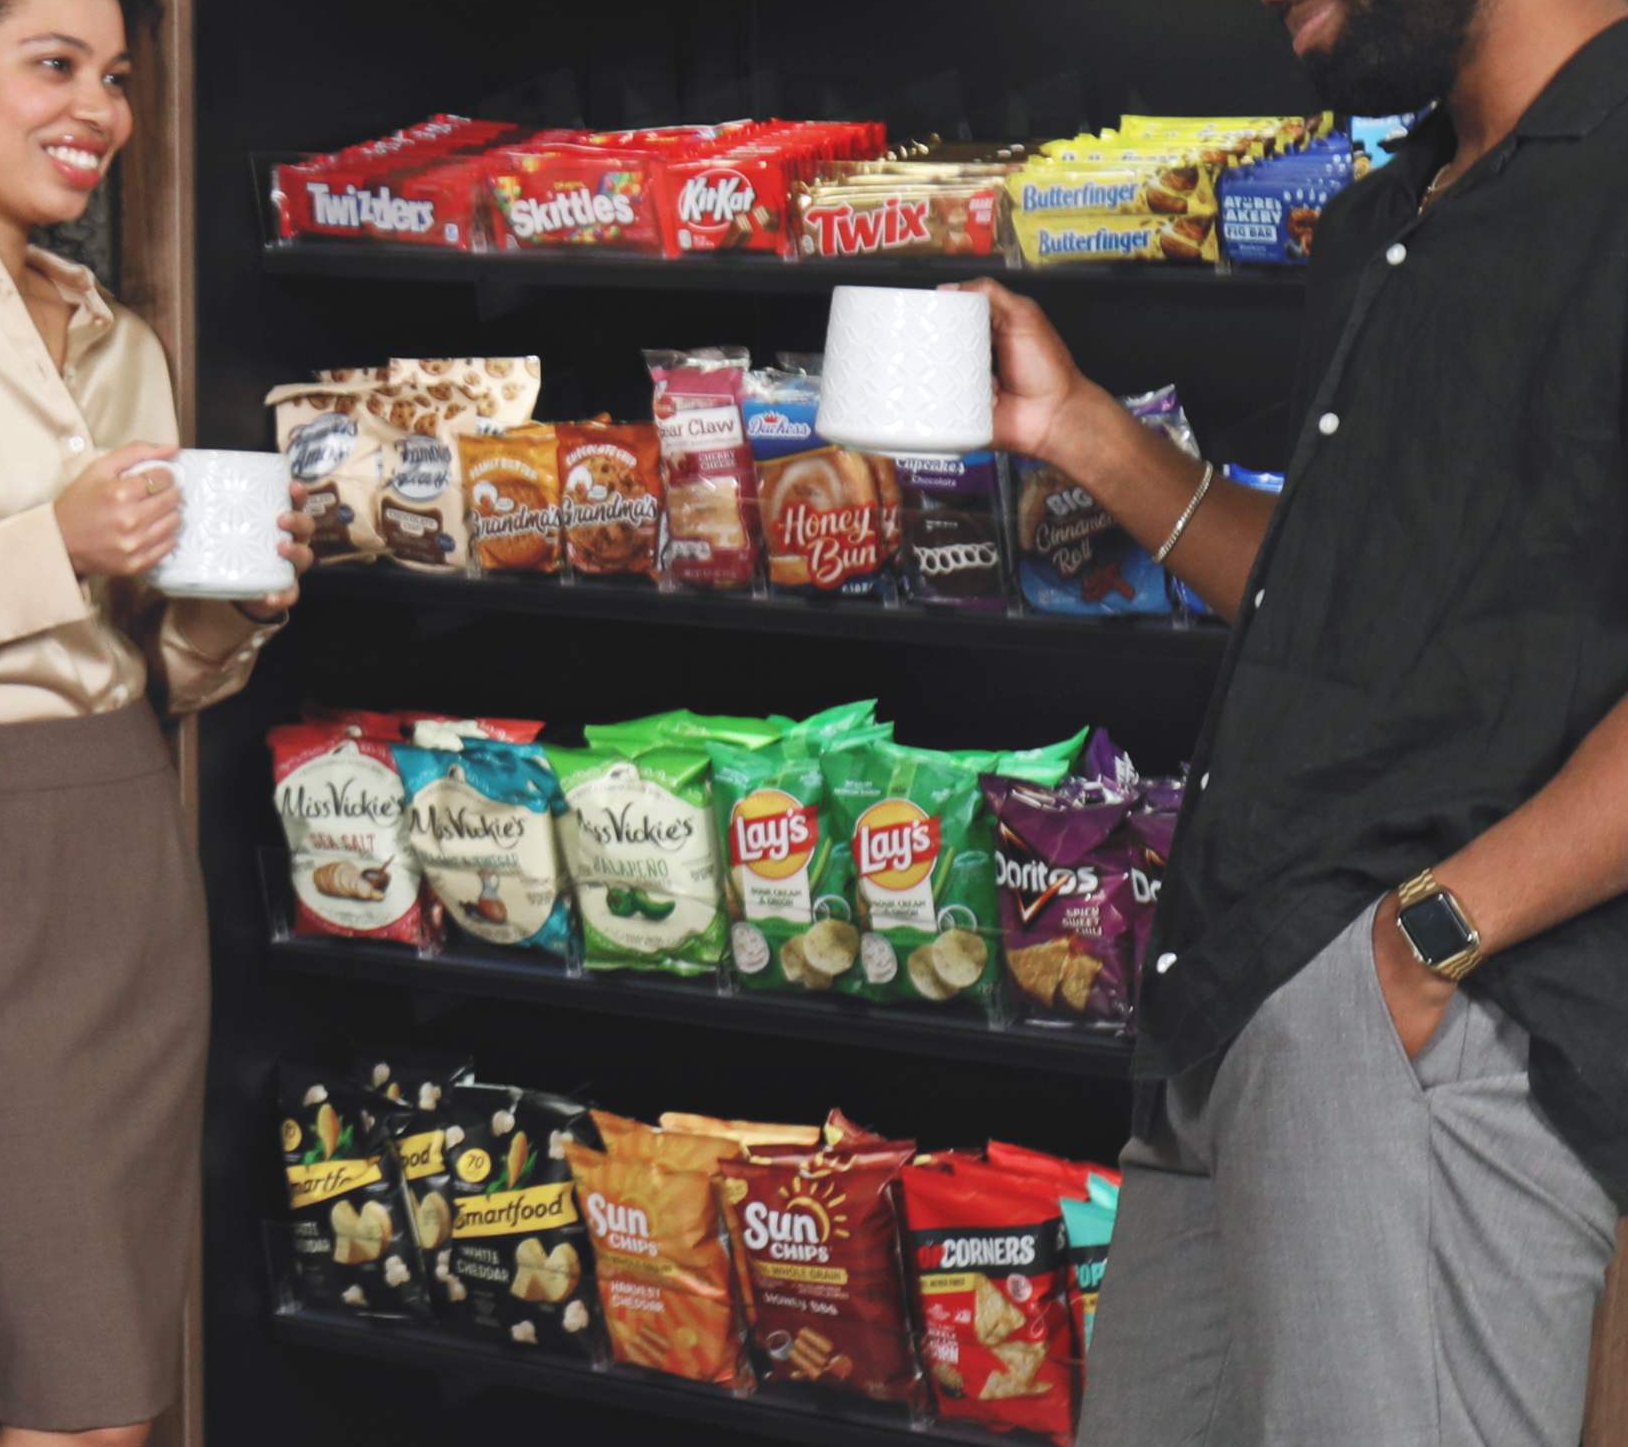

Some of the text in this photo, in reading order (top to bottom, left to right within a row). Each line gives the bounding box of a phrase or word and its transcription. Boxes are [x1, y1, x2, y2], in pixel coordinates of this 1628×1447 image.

[511, 186, 634, 237] Skittles
[1022, 181, 1140, 213] Butterfinger
[1038, 229, 1153, 255] Butterfinger
[688, 419, 734, 436] Claw
[748, 417, 810, 436] Duchess
[562, 492, 658, 528] Grandma's
[1046, 487, 1092, 515] BIG
[785, 503, 871, 550] Honey
[810, 541, 877, 582] Bun
[1052, 543, 1093, 575] Roll
[280, 786, 326, 819] Miss
[341, 833, 375, 852] SALT
[604, 802, 693, 852] Vickie's
[736, 808, 808, 861] Lay's
[860, 820, 930, 872] Lay's
[995, 850, 1098, 895] Doritos
[467, 1155, 484, 1169] 70
[453, 1195, 564, 1228] Smartfood
[587, 1193, 649, 1238] Sun
[744, 1202, 819, 1250] Sun
[609, 1234, 659, 1258] CHIPS
[770, 1242, 830, 1263] CHIPS
[457, 1262, 510, 1283] CHEDDAR
